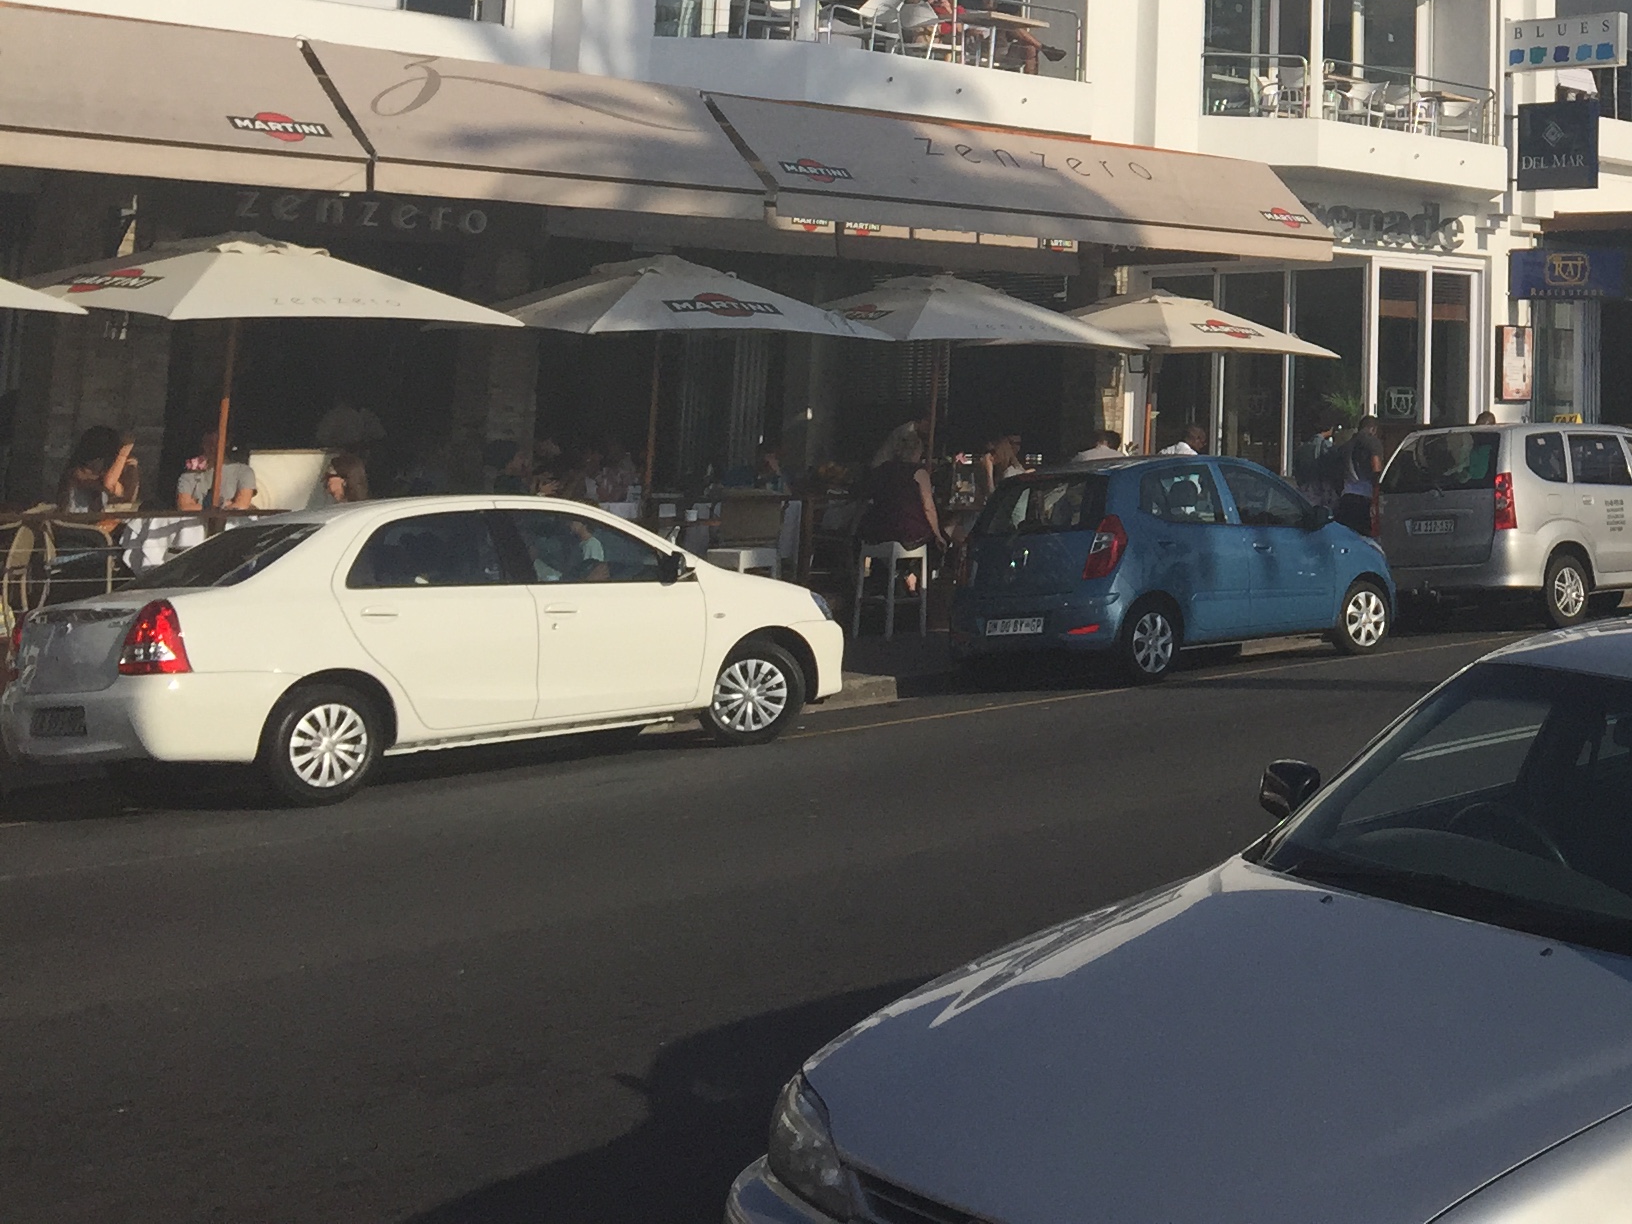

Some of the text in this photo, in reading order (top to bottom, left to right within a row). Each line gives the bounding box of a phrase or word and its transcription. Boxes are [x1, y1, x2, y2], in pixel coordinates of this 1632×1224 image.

[1514, 20, 1610, 40] BLUES
[234, 118, 325, 135] MARTINI
[914, 137, 1154, 181] zenzero
[1522, 154, 1585, 170] DEL MAR
[784, 162, 849, 178] MARTINI
[235, 189, 488, 234] zenzero
[1264, 211, 1309, 224] MARTINI
[846, 222, 881, 231] MARTINI
[1552, 258, 1584, 282] RAJ
[1530, 287, 1604, 297] Restaurant
[671, 301, 776, 314] MARTINI
[1391, 390, 1414, 415] RAJ
